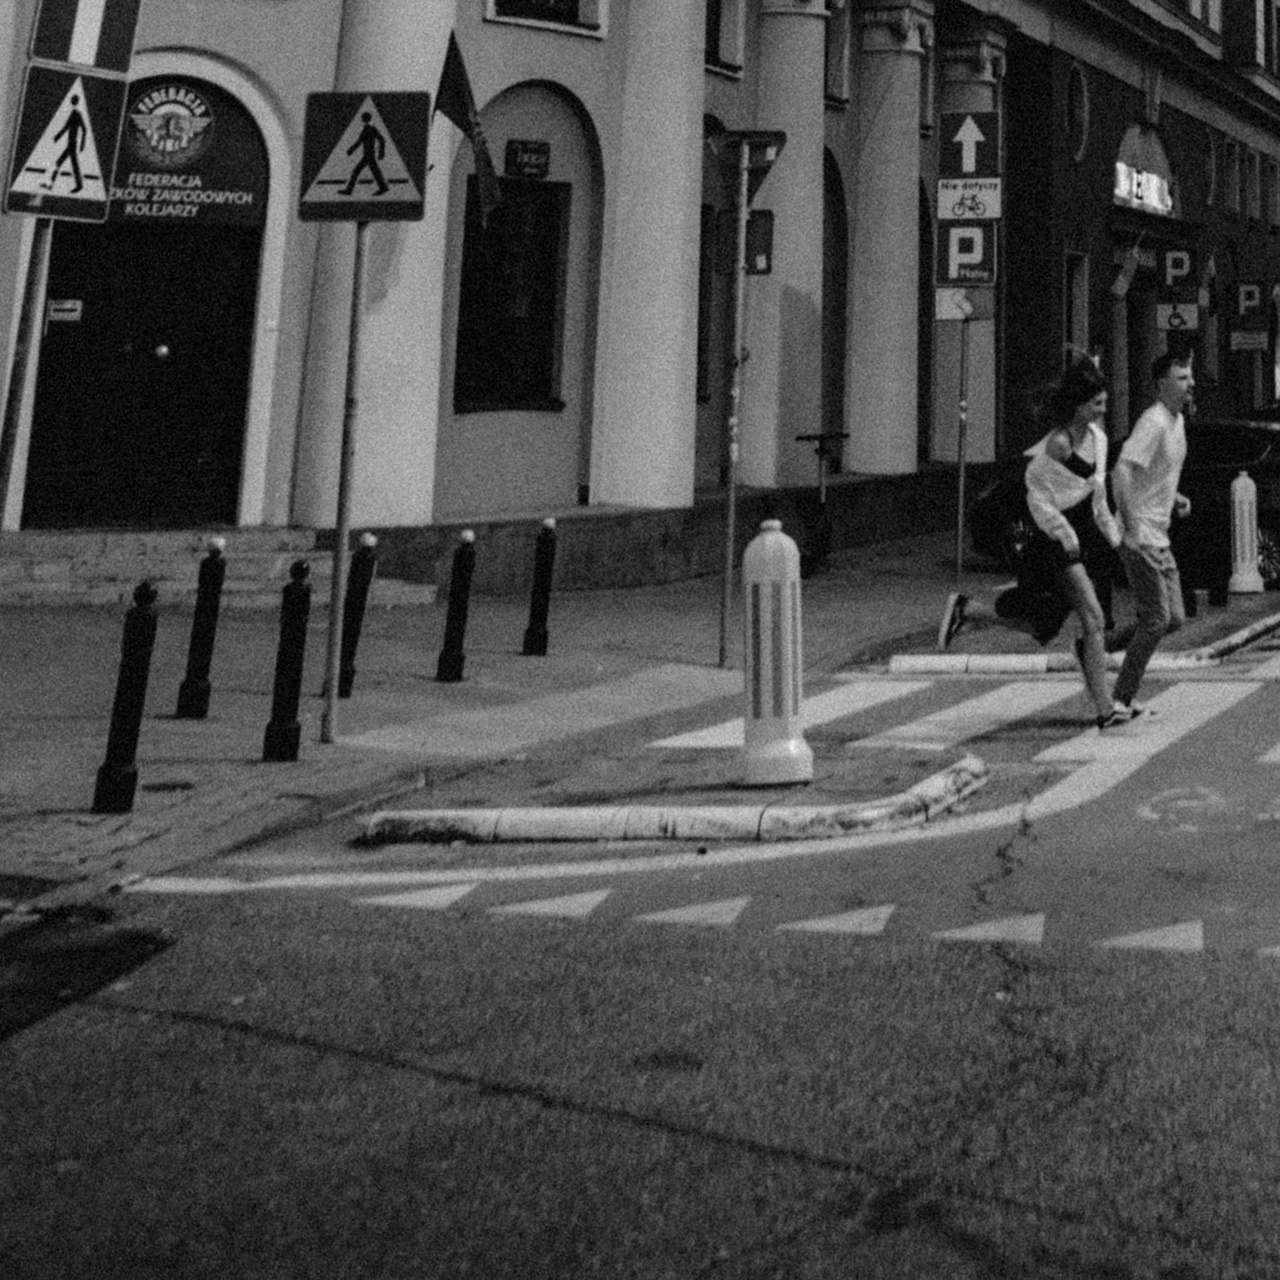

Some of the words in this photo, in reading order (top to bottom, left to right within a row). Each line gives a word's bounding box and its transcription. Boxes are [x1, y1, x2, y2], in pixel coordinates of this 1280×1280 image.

[128, 172, 202, 188] FEDERACJA
[152, 188, 253, 205] ZAWODOWYCH
[125, 203, 199, 217] KOLEJARZY
[949, 227, 983, 279] P
[1166, 251, 1190, 286] P
[1239, 285, 1260, 315] P
